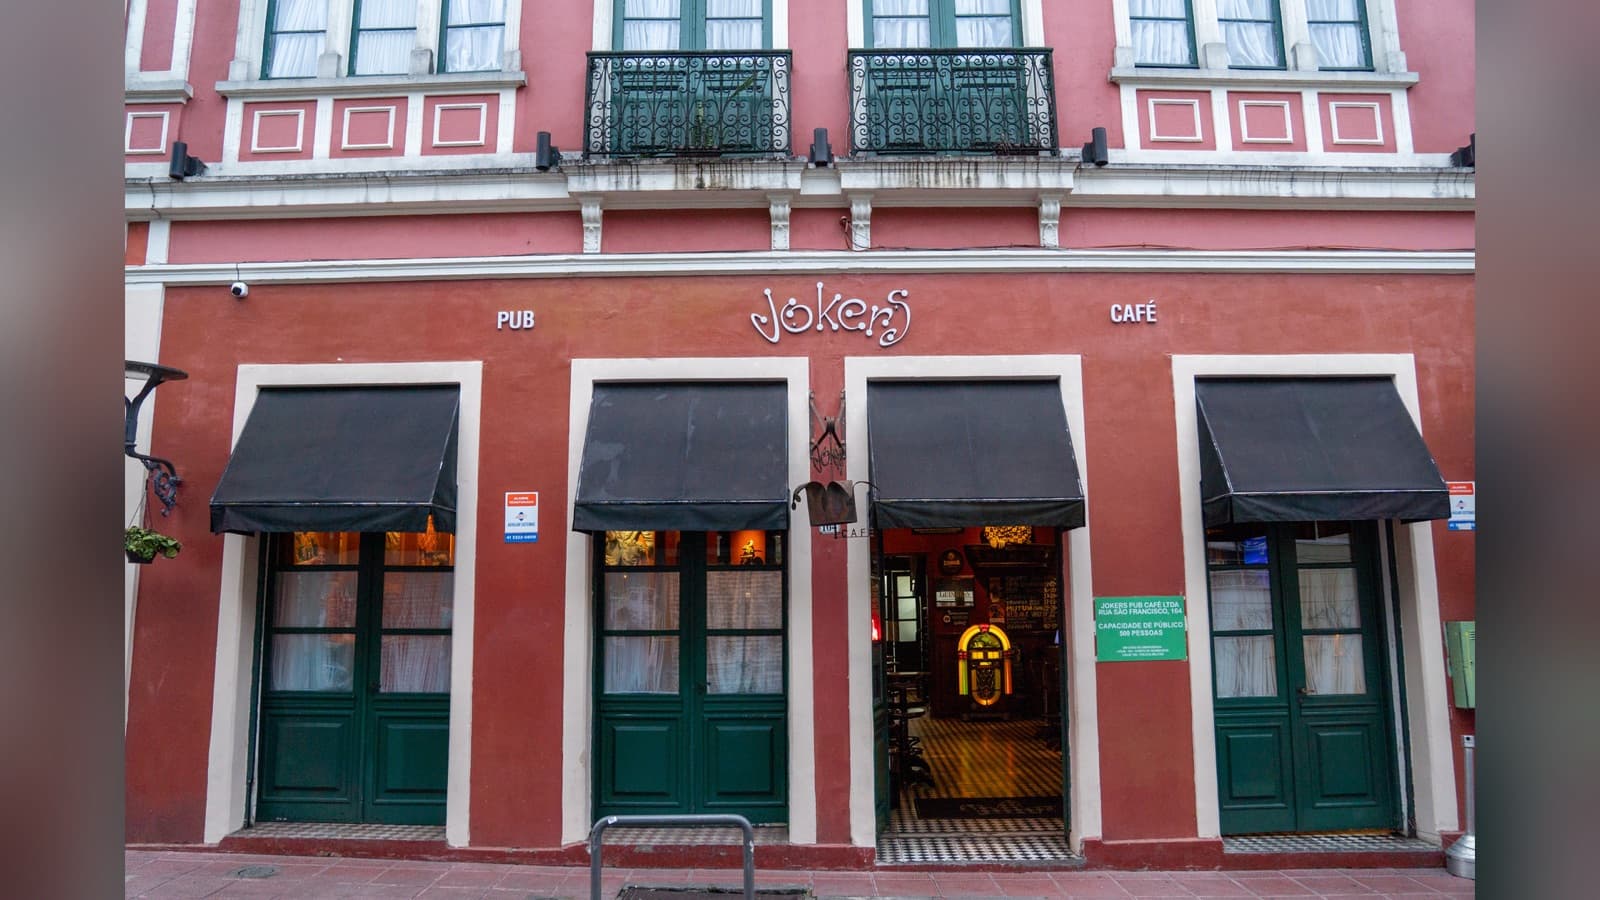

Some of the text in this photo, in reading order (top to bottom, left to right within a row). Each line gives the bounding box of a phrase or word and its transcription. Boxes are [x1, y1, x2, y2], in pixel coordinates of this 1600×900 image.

[1110, 299, 1157, 323] CAFÉ
[497, 310, 535, 329] PUB
[1113, 607, 1127, 615] SÃO
[1098, 622, 1142, 630] CAPACIDADE
[1153, 620, 1184, 629] PÚBLICO
[1131, 629, 1163, 637] PESSOAS
